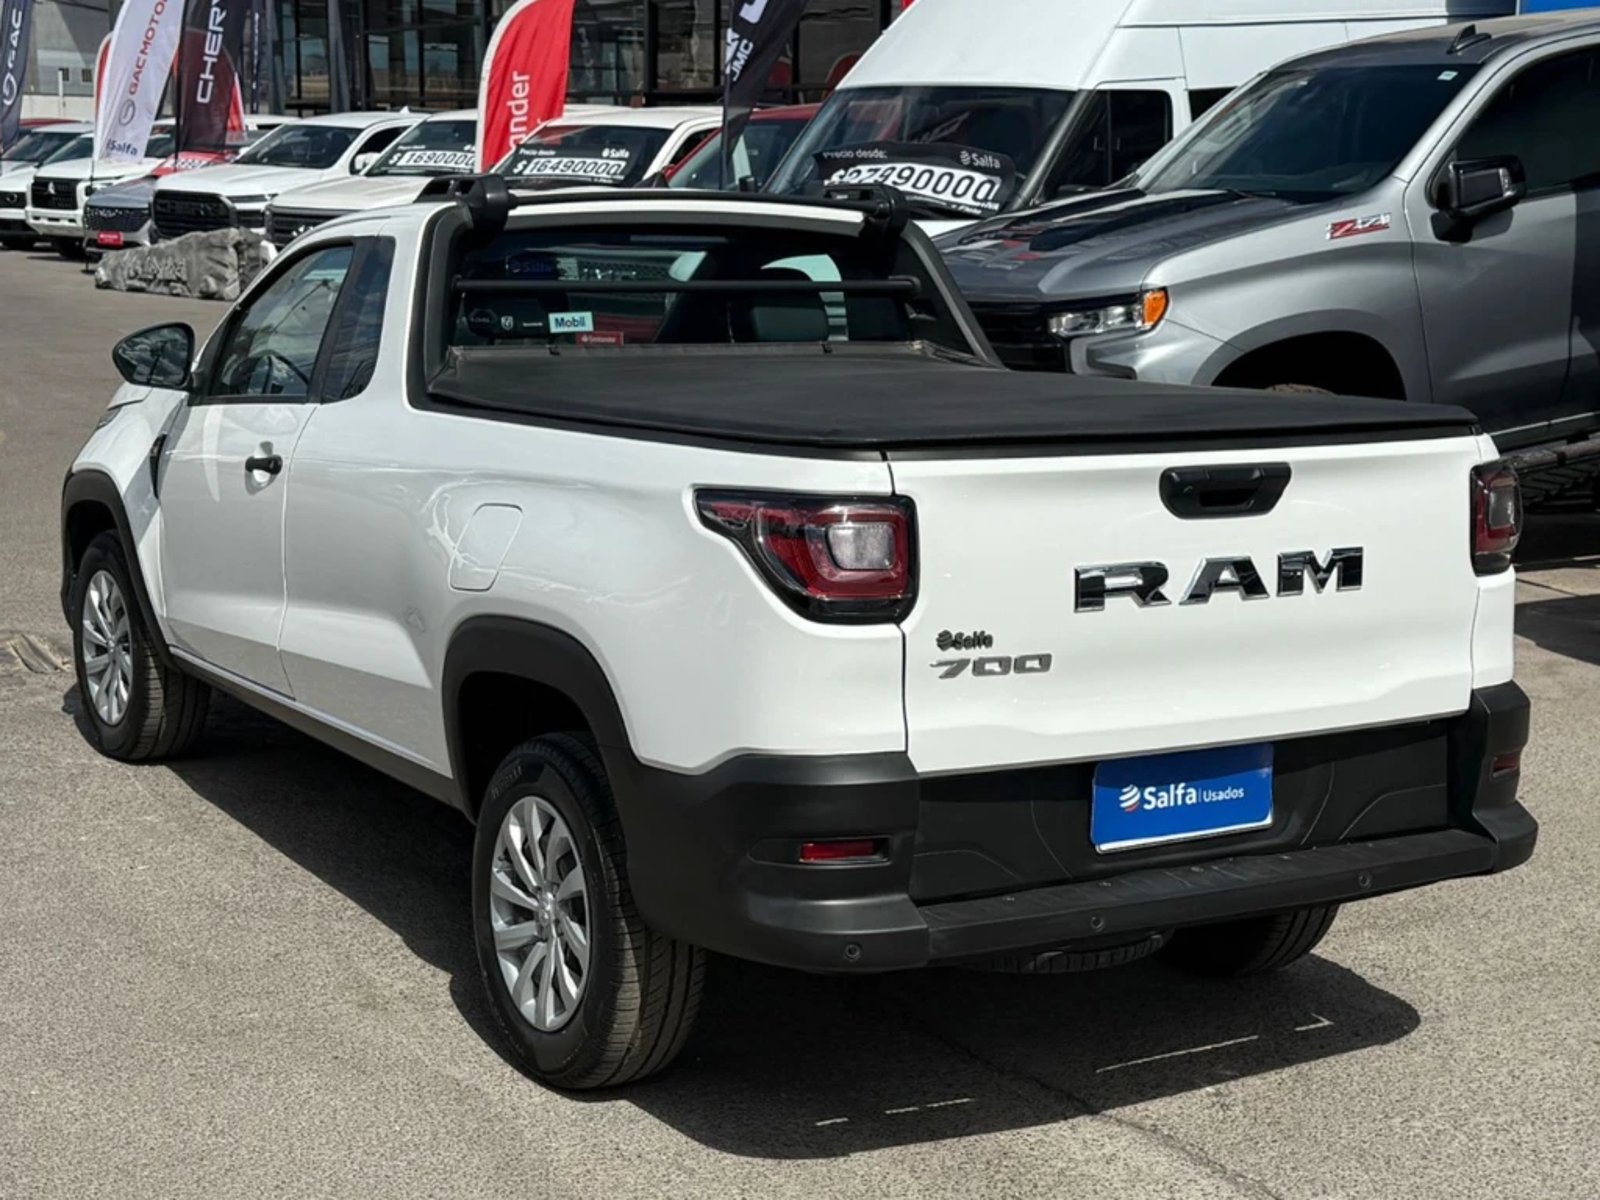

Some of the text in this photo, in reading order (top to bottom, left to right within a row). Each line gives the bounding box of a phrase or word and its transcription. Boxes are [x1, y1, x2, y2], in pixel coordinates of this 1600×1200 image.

[731, 38, 754, 82] JMC
[528, 158, 624, 177] 16490000
[971, 153, 1001, 169] Salfa
[554, 316, 586, 329] Mobil
[1073, 545, 1364, 613] RAM
[954, 630, 993, 650] Salfa
[930, 653, 1052, 679] 700
[1143, 782, 1245, 810] Salfa Usados
